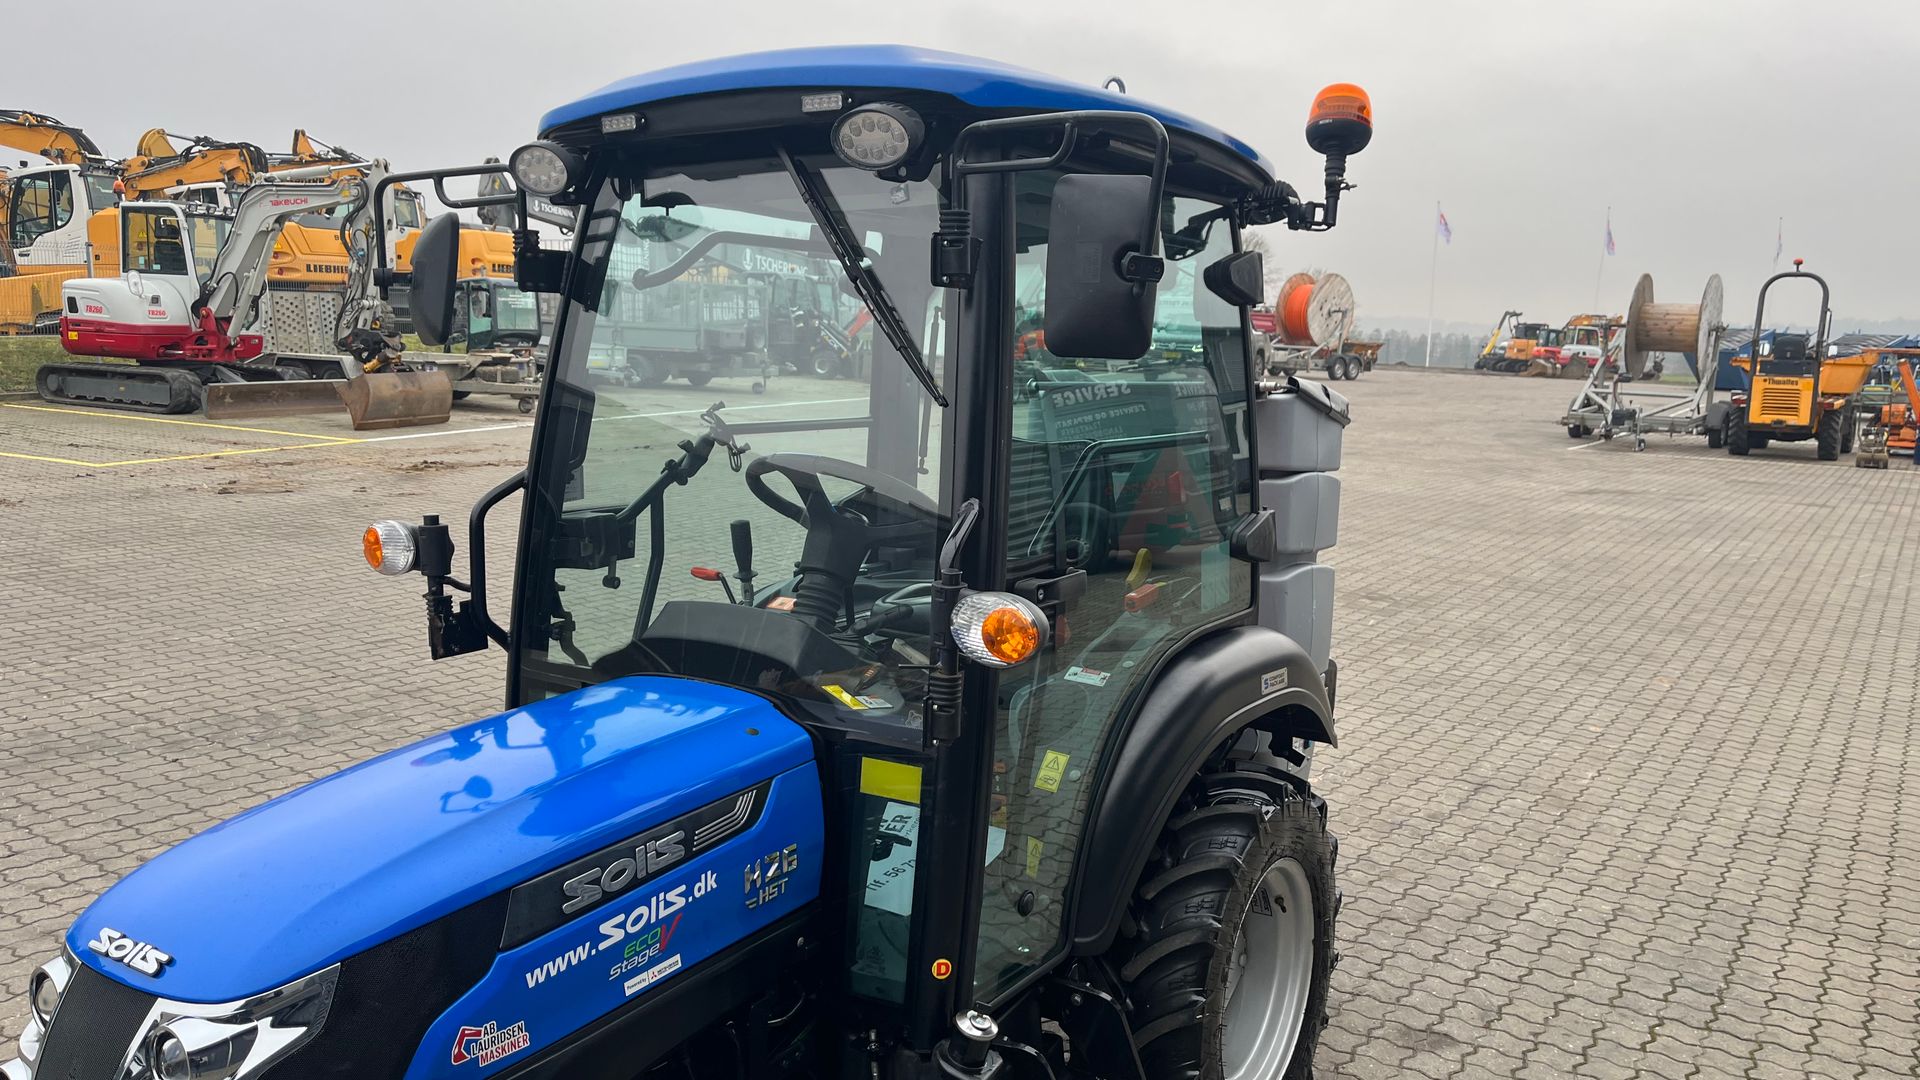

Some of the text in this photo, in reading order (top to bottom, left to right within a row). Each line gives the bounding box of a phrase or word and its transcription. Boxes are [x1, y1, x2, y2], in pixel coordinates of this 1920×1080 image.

[269, 197, 308, 207] TAKEUCHI
[759, 877, 789, 905] HST
[471, 1022, 524, 1056] LAURIDSEN
[483, 1022, 496, 1038] AB
[480, 1033, 529, 1065] MASKINER
